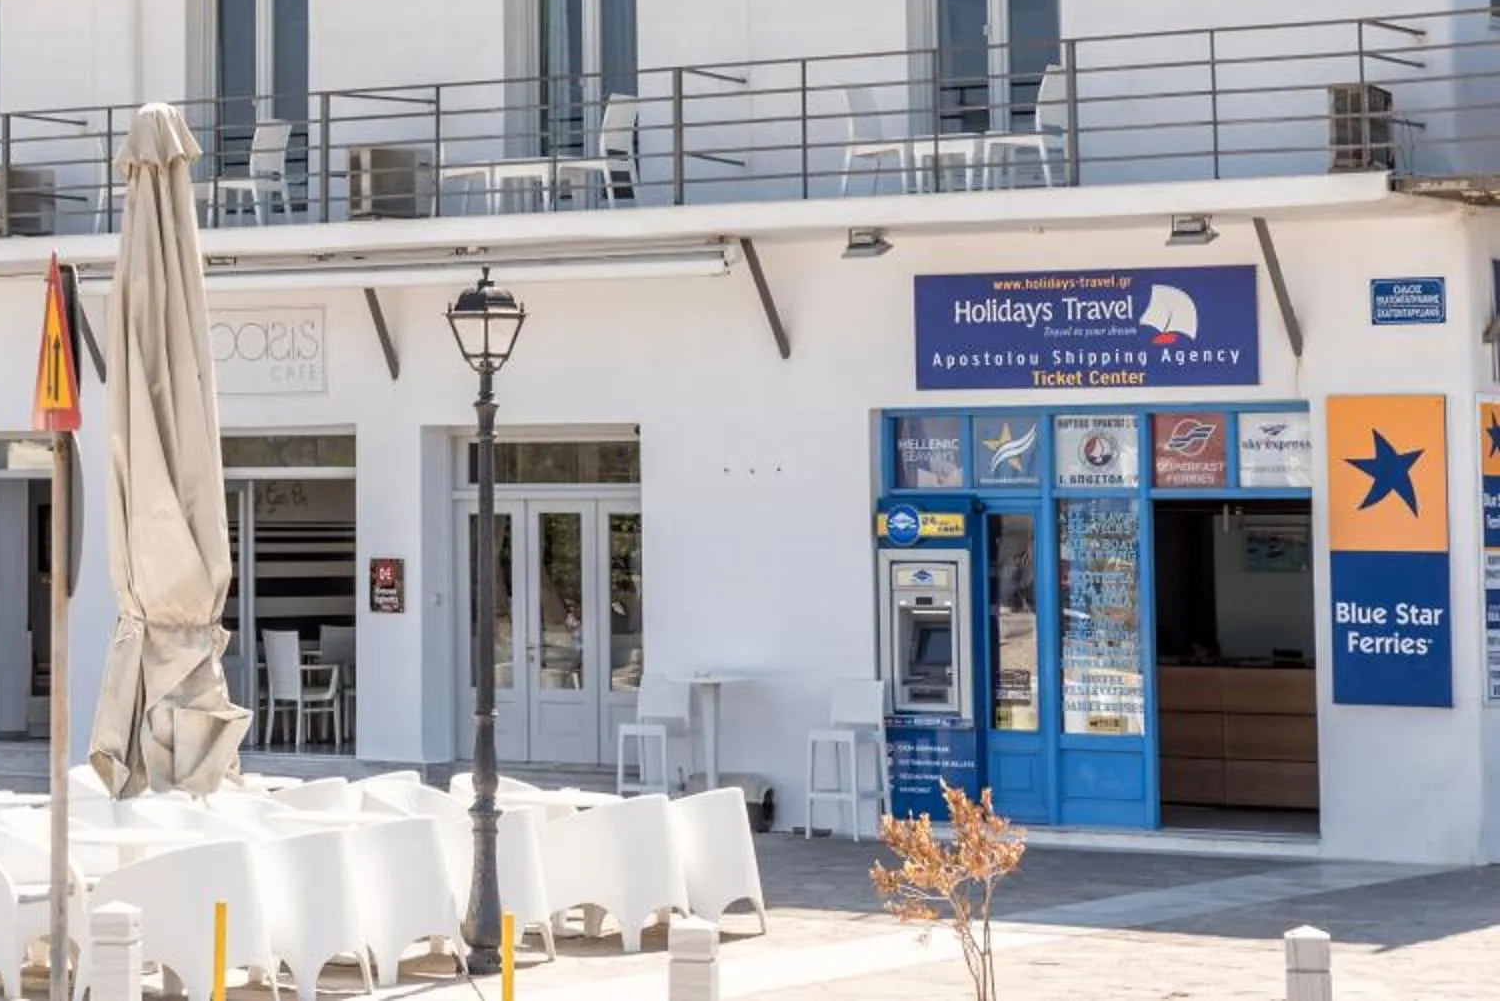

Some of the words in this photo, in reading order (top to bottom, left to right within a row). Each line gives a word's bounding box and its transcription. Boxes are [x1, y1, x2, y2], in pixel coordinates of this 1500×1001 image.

[993, 275, 1132, 291] www.holidays-travel.gr
[953, 298, 1054, 328] Holidays
[1061, 294, 1133, 321] Travel
[931, 350, 1040, 369] Apostolou
[1053, 348, 1148, 367] Shipping
[1160, 347, 1241, 364] Agency
[1030, 370, 1082, 387] Ticket
[1088, 369, 1147, 385] Center
[897, 438, 960, 450] HELLENIC
[1335, 601, 1388, 624] Blue
[1395, 602, 1444, 626] Star
[1347, 631, 1429, 655] Ferries
